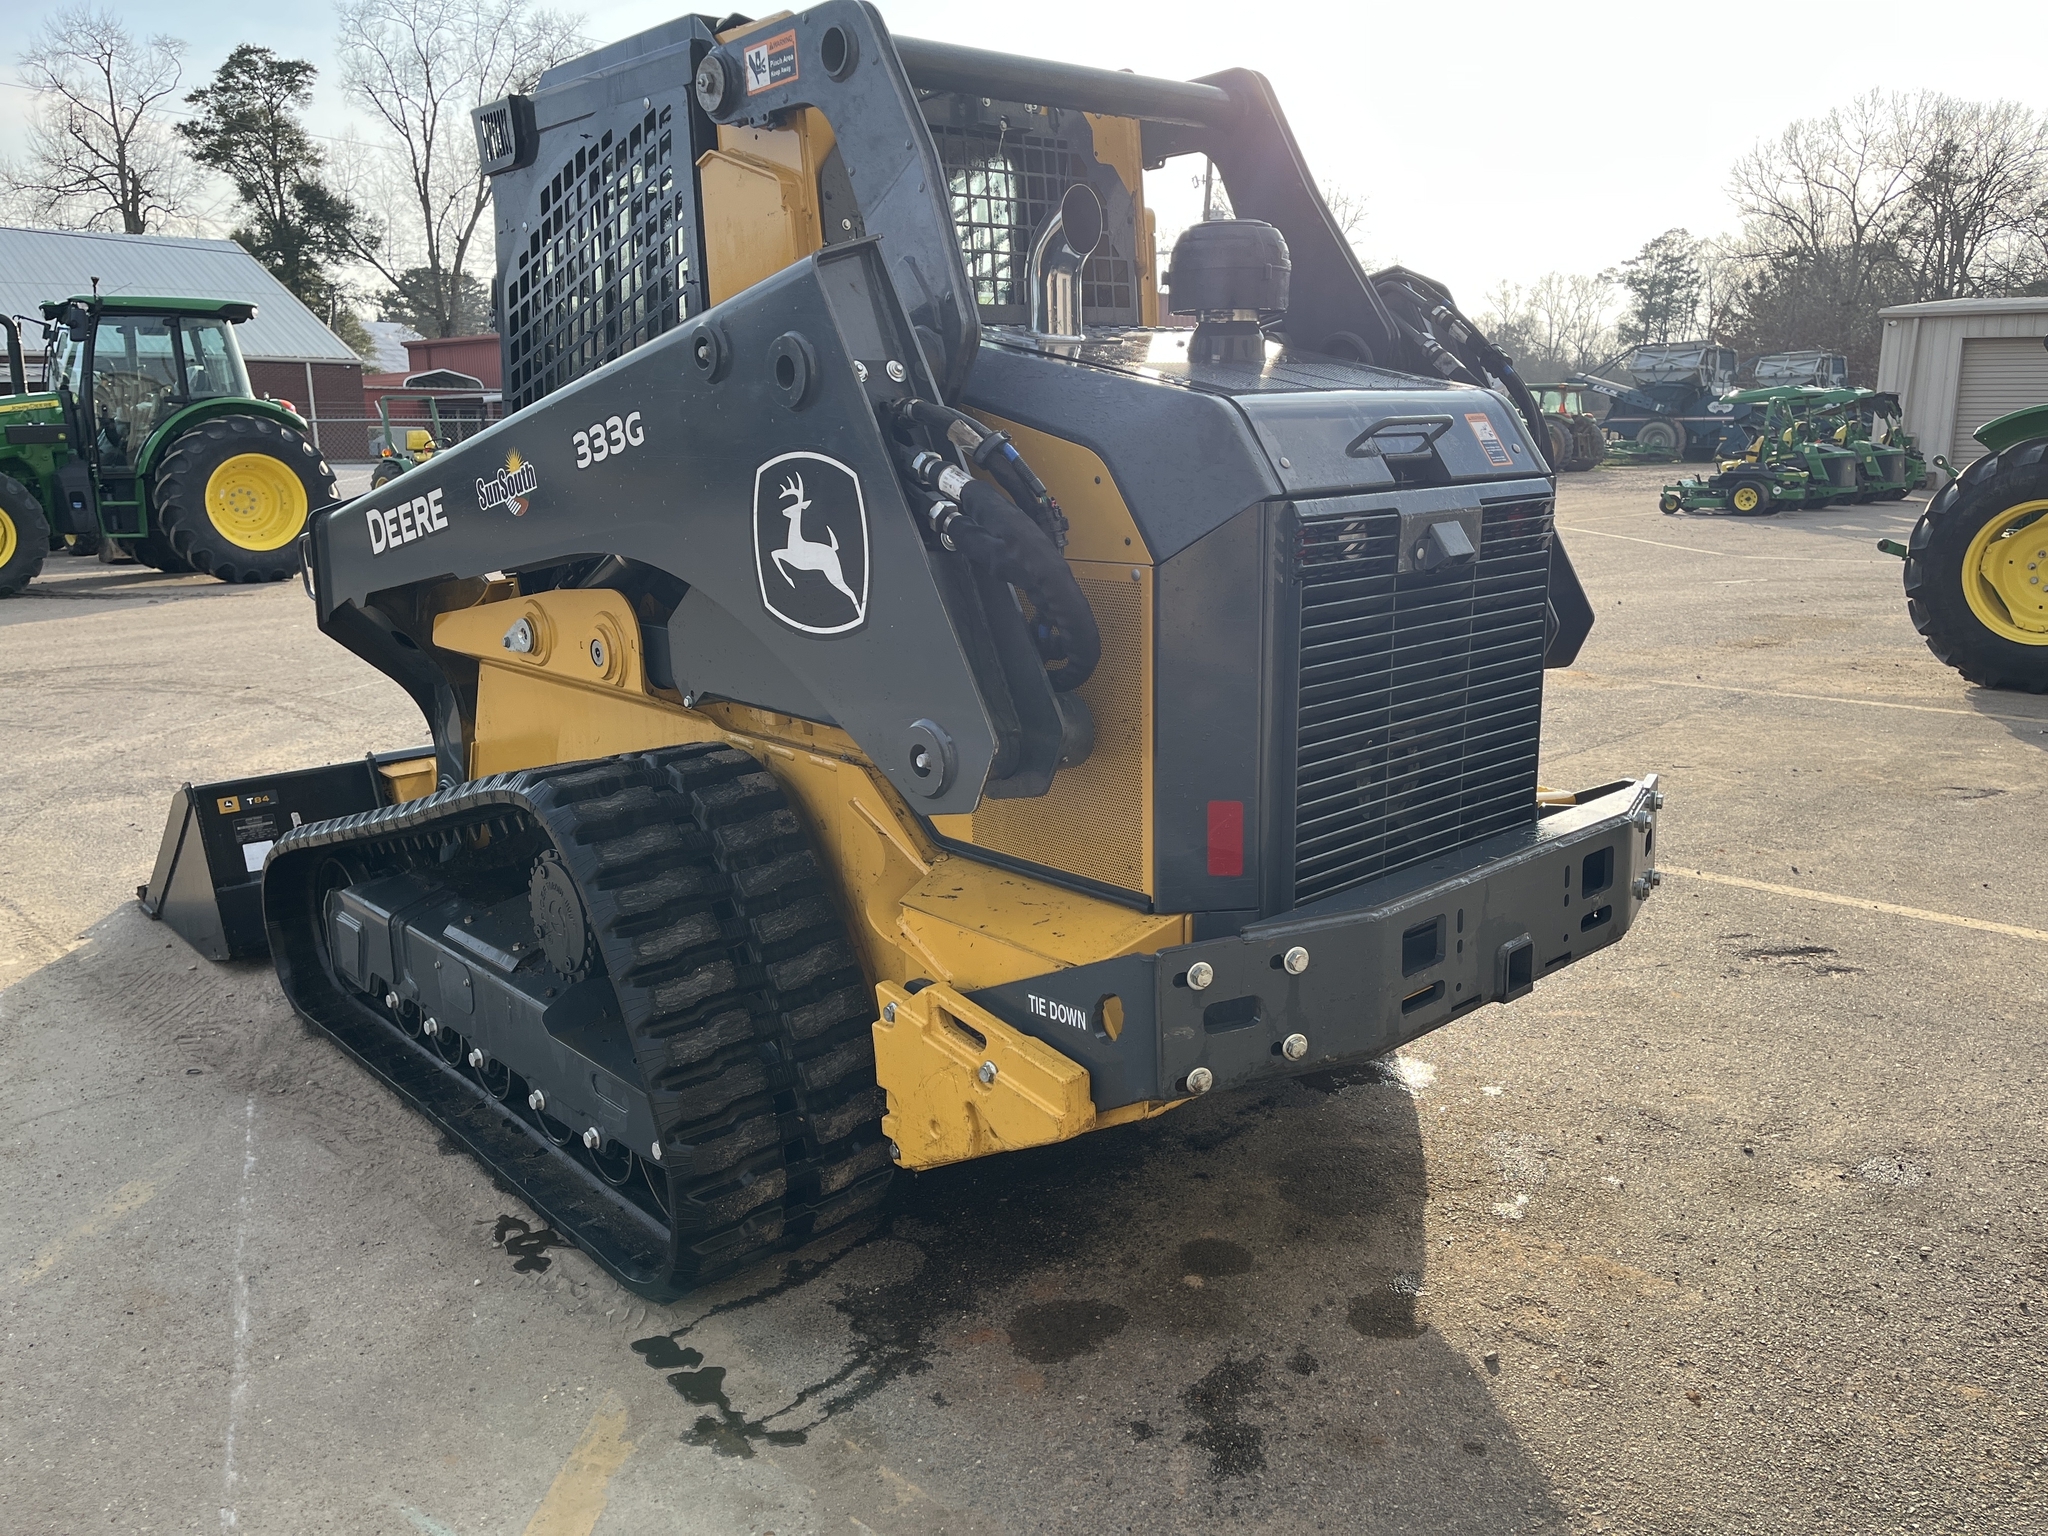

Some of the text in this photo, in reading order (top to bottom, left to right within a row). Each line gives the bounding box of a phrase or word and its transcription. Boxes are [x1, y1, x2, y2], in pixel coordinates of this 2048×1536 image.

[773, 35, 792, 48] WARNING
[770, 54, 794, 68] Pinch Area
[771, 69, 781, 77] Keep
[572, 411, 646, 469] 333G
[476, 461, 538, 511] SunSouth
[365, 487, 449, 556] DEERE
[246, 795, 270, 805] T84
[1028, 993, 1087, 1031] TIE DOWN
